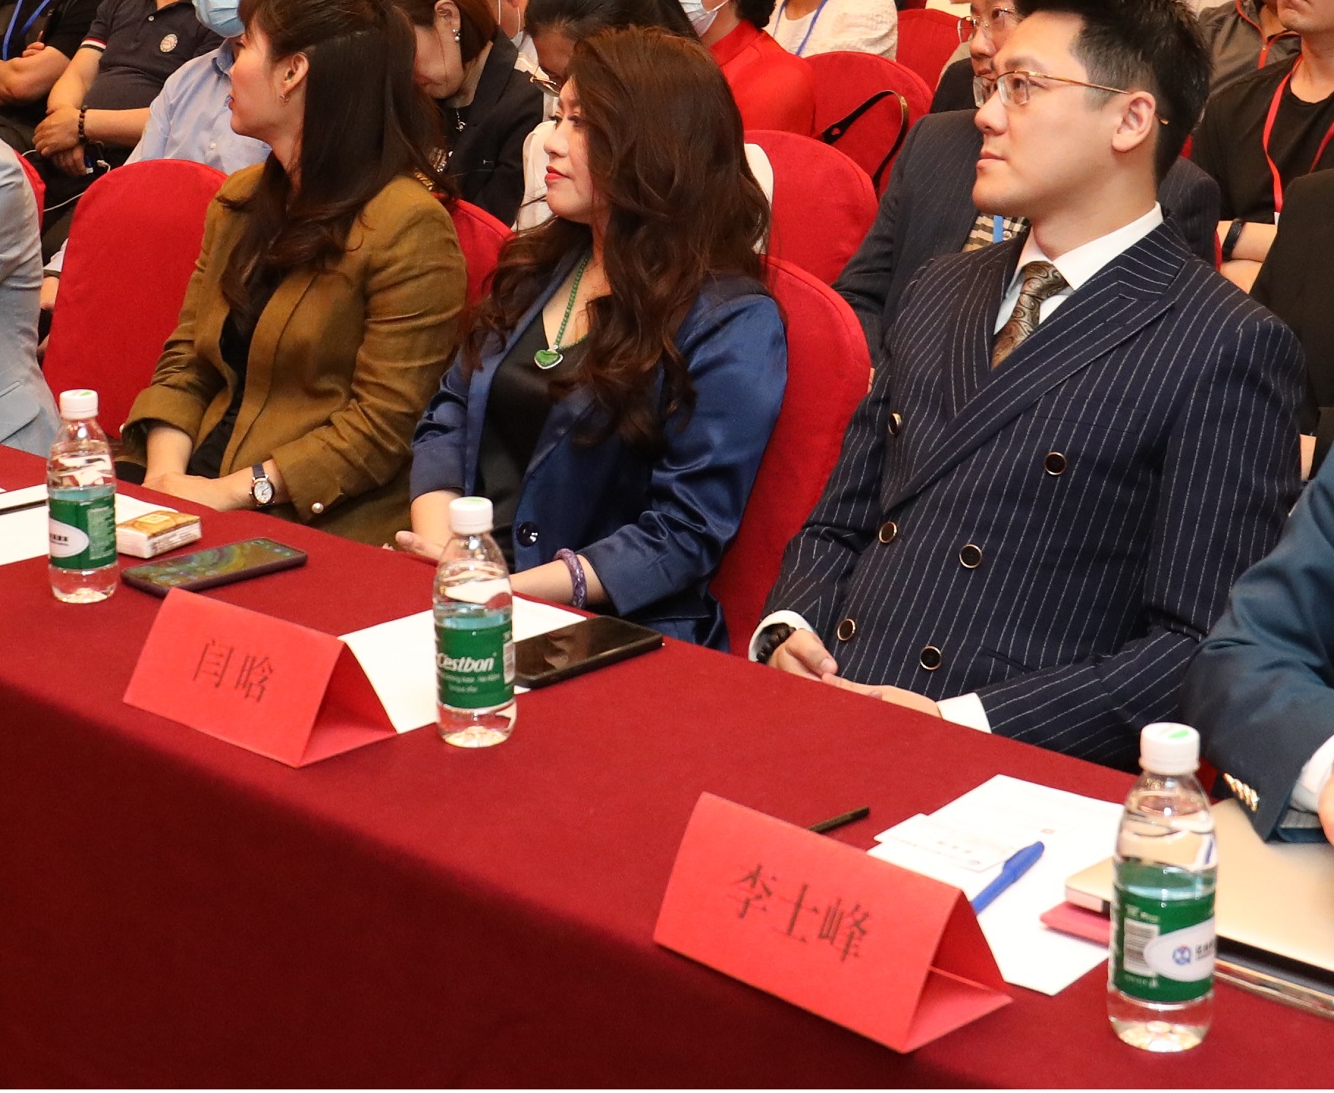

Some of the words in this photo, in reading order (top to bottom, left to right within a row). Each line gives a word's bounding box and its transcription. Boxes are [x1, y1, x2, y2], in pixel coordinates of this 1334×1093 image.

[193, 638, 273, 702] 闫晗
[728, 864, 869, 962] 李士峰
